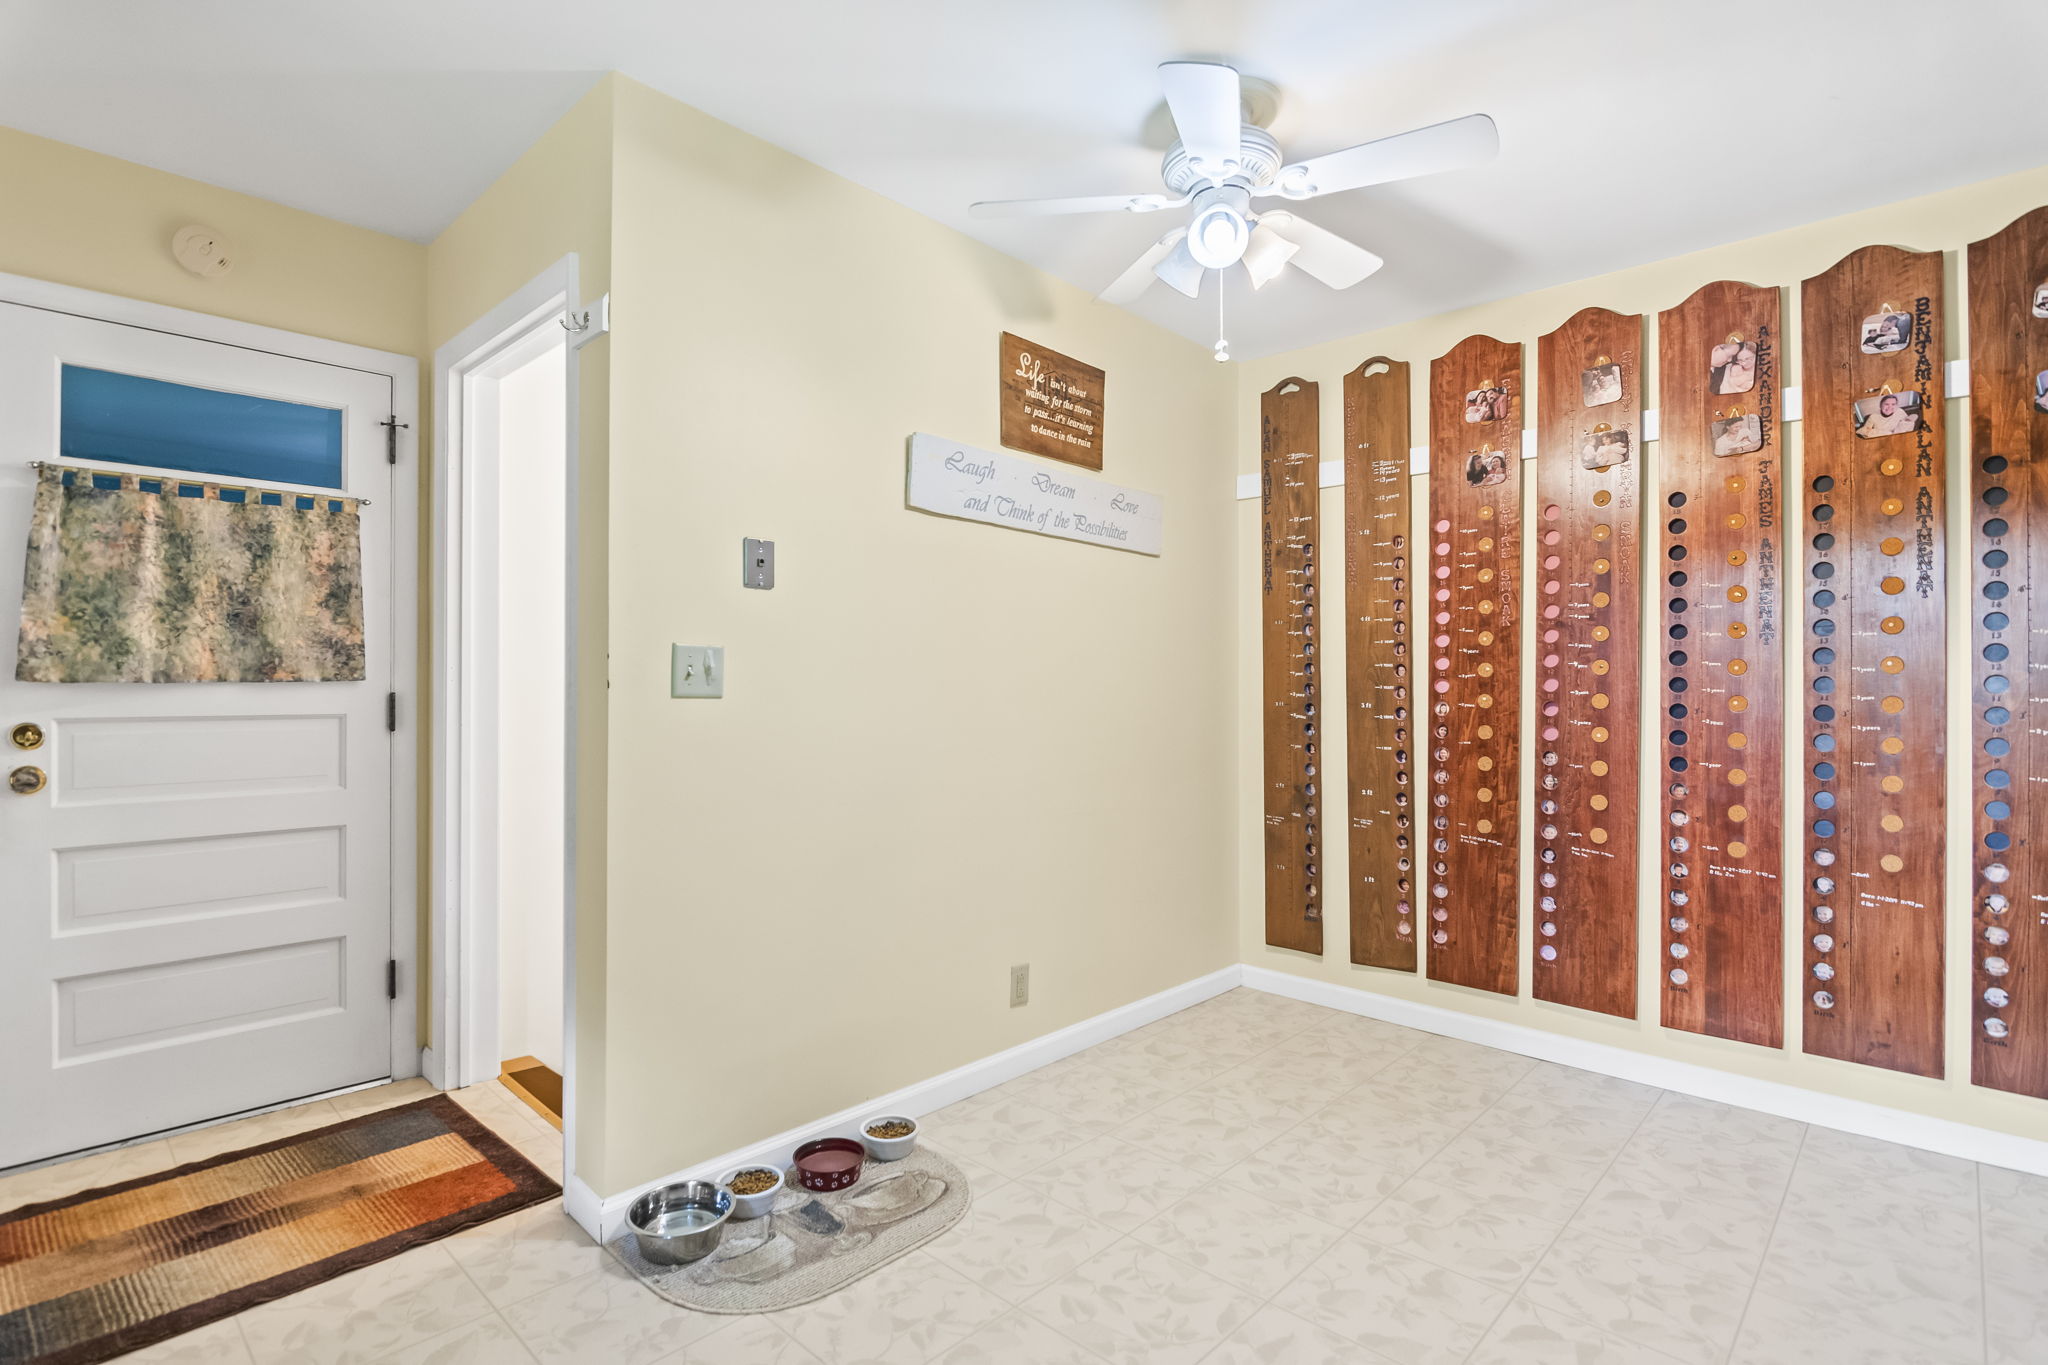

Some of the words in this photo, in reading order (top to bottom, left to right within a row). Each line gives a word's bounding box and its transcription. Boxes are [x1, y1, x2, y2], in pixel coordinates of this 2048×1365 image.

[1016, 353, 1045, 390] Life
[1050, 379, 1065, 392] isn't
[1068, 385, 1087, 398] about
[1914, 297, 1932, 409] BENJAMIN
[1025, 389, 1050, 405] waiting
[1050, 396, 1062, 408] for
[1063, 399, 1073, 410] the
[1074, 404, 1092, 417] storm
[1758, 325, 1773, 447] ALEXANDER
[1024, 405, 1031, 414] to
[1066, 418, 1094, 435] learning
[1031, 424, 1038, 432] to
[1039, 424, 1057, 439] dance
[1058, 431, 1065, 441] in
[1066, 433, 1077, 445] the
[1077, 439, 1091, 449] rain
[1914, 420, 1933, 477] ALAN
[944, 451, 995, 485] Laugh
[1031, 471, 1076, 500] Dream
[1110, 492, 1139, 515] Love
[1759, 460, 1773, 528] JAMES
[963, 495, 991, 512] and
[994, 496, 1035, 523] Think
[1037, 509, 1053, 531] of
[1054, 511, 1070, 529] the
[1073, 512, 1129, 542] Possibilities
[1915, 486, 1934, 599] ANTHENAT
[1501, 569, 1511, 627] SMOAK
